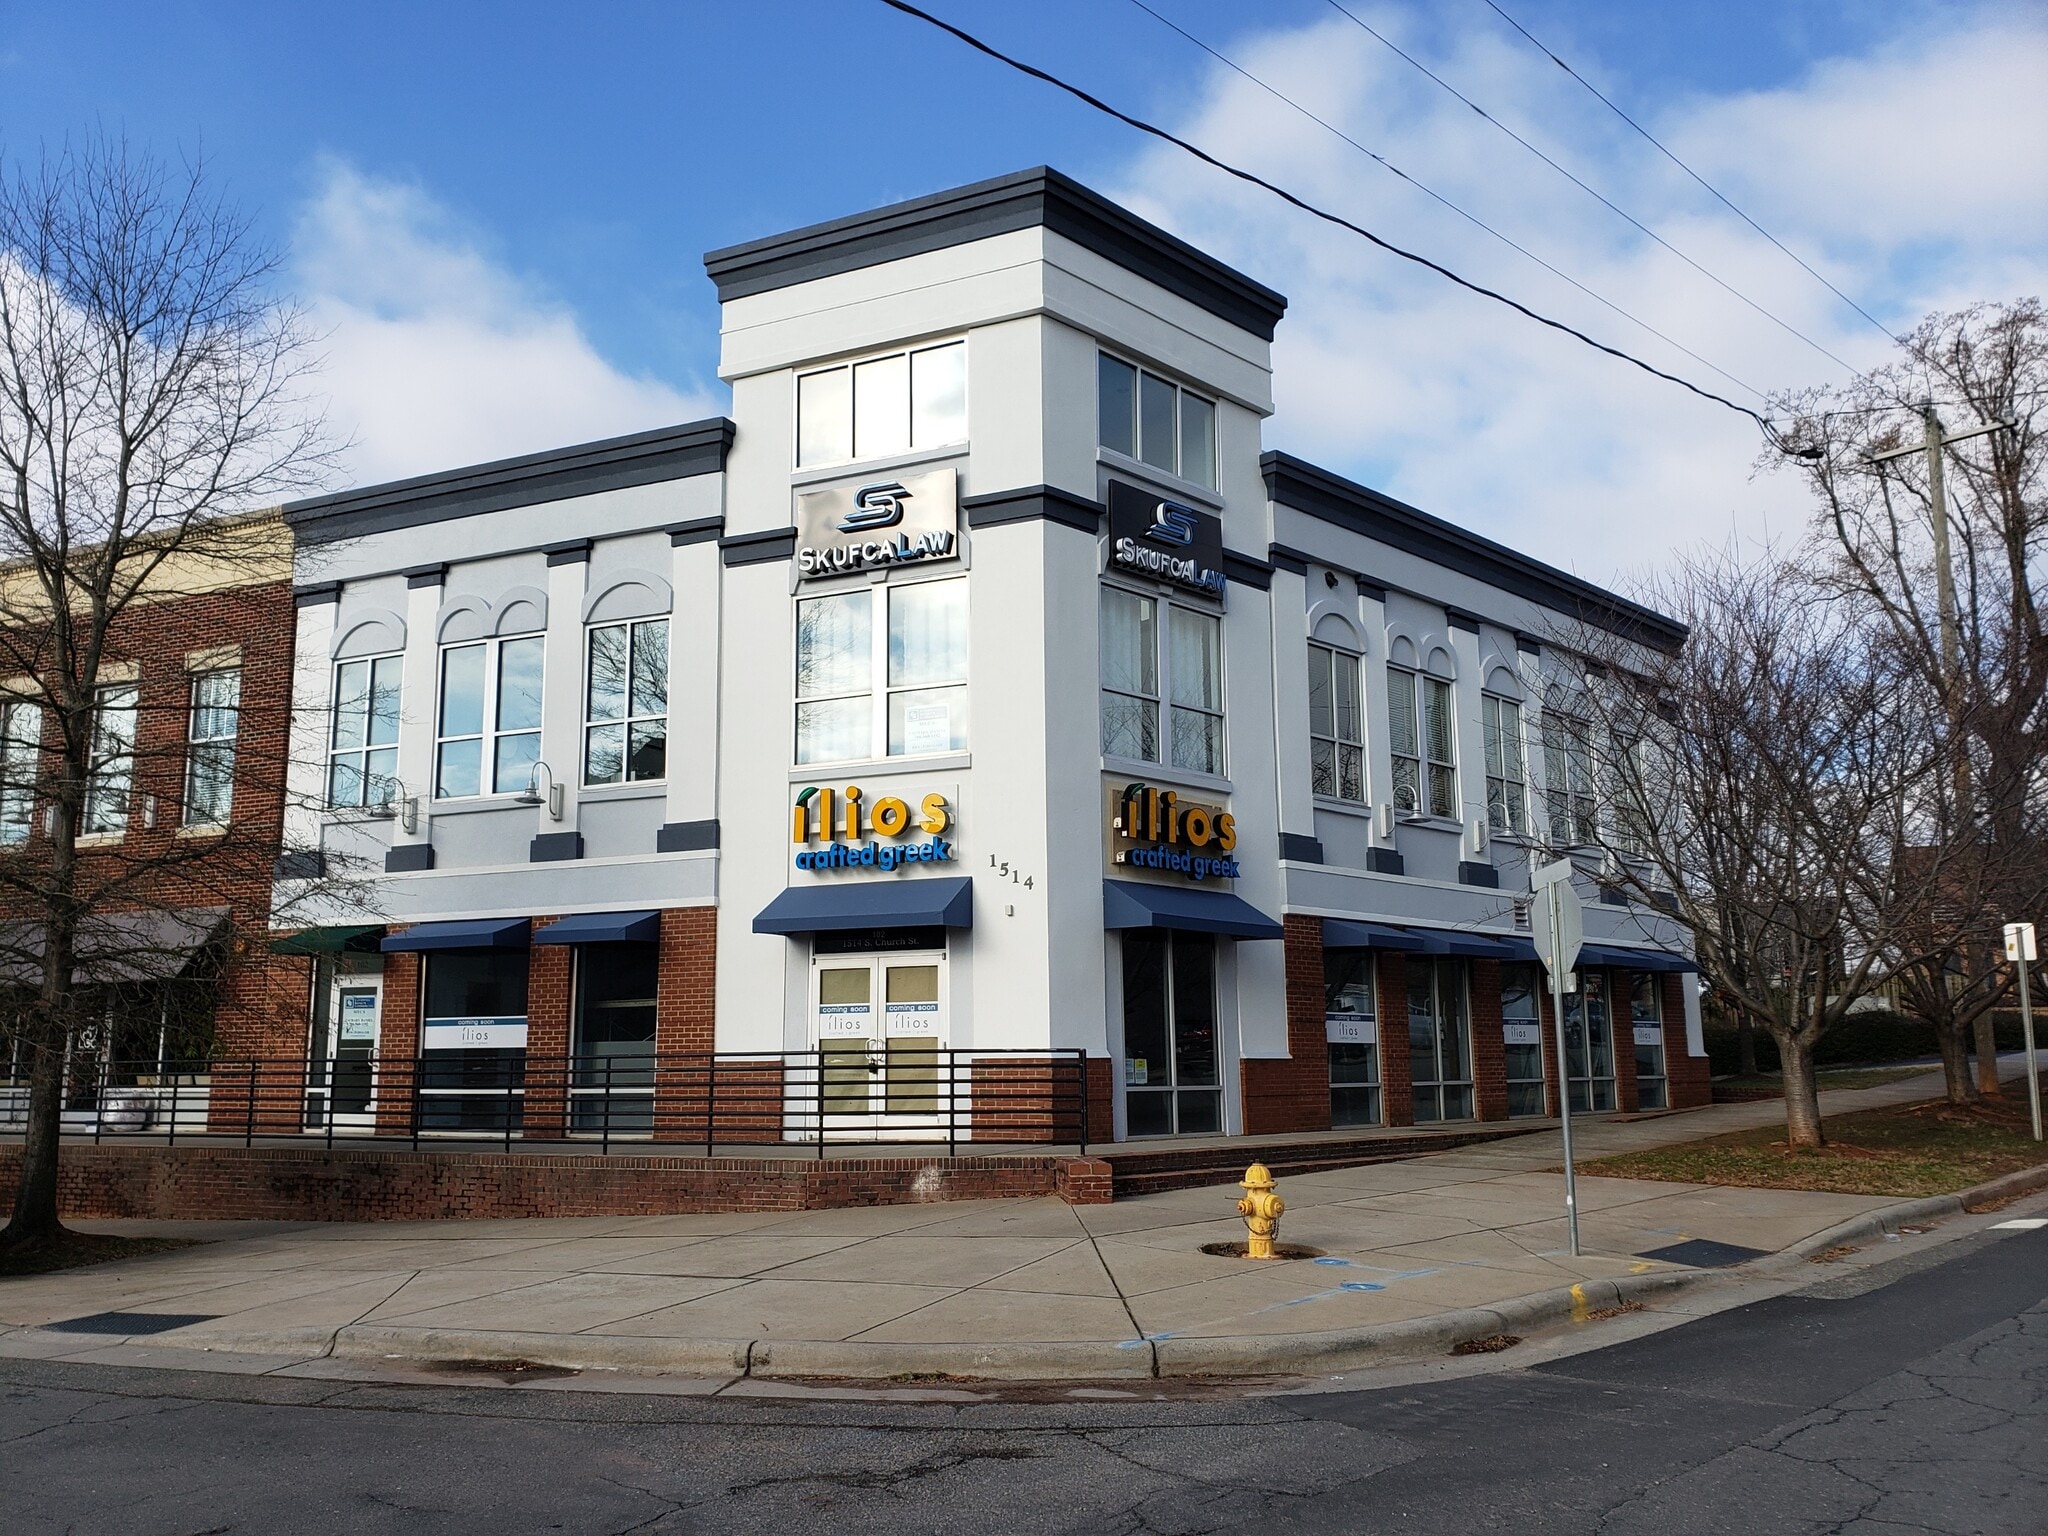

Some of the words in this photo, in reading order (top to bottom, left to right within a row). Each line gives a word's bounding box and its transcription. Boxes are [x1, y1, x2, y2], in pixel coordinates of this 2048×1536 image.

[796, 840, 879, 870] crafted
[878, 836, 952, 872] greek
[1127, 845, 1191, 871] crafted
[1190, 855, 1240, 880] greek
[989, 853, 1034, 891] 1514
[864, 939, 873, 947] S.
[875, 937, 906, 947] Church
[907, 936, 920, 945] St.
[822, 1006, 848, 1014] coming
